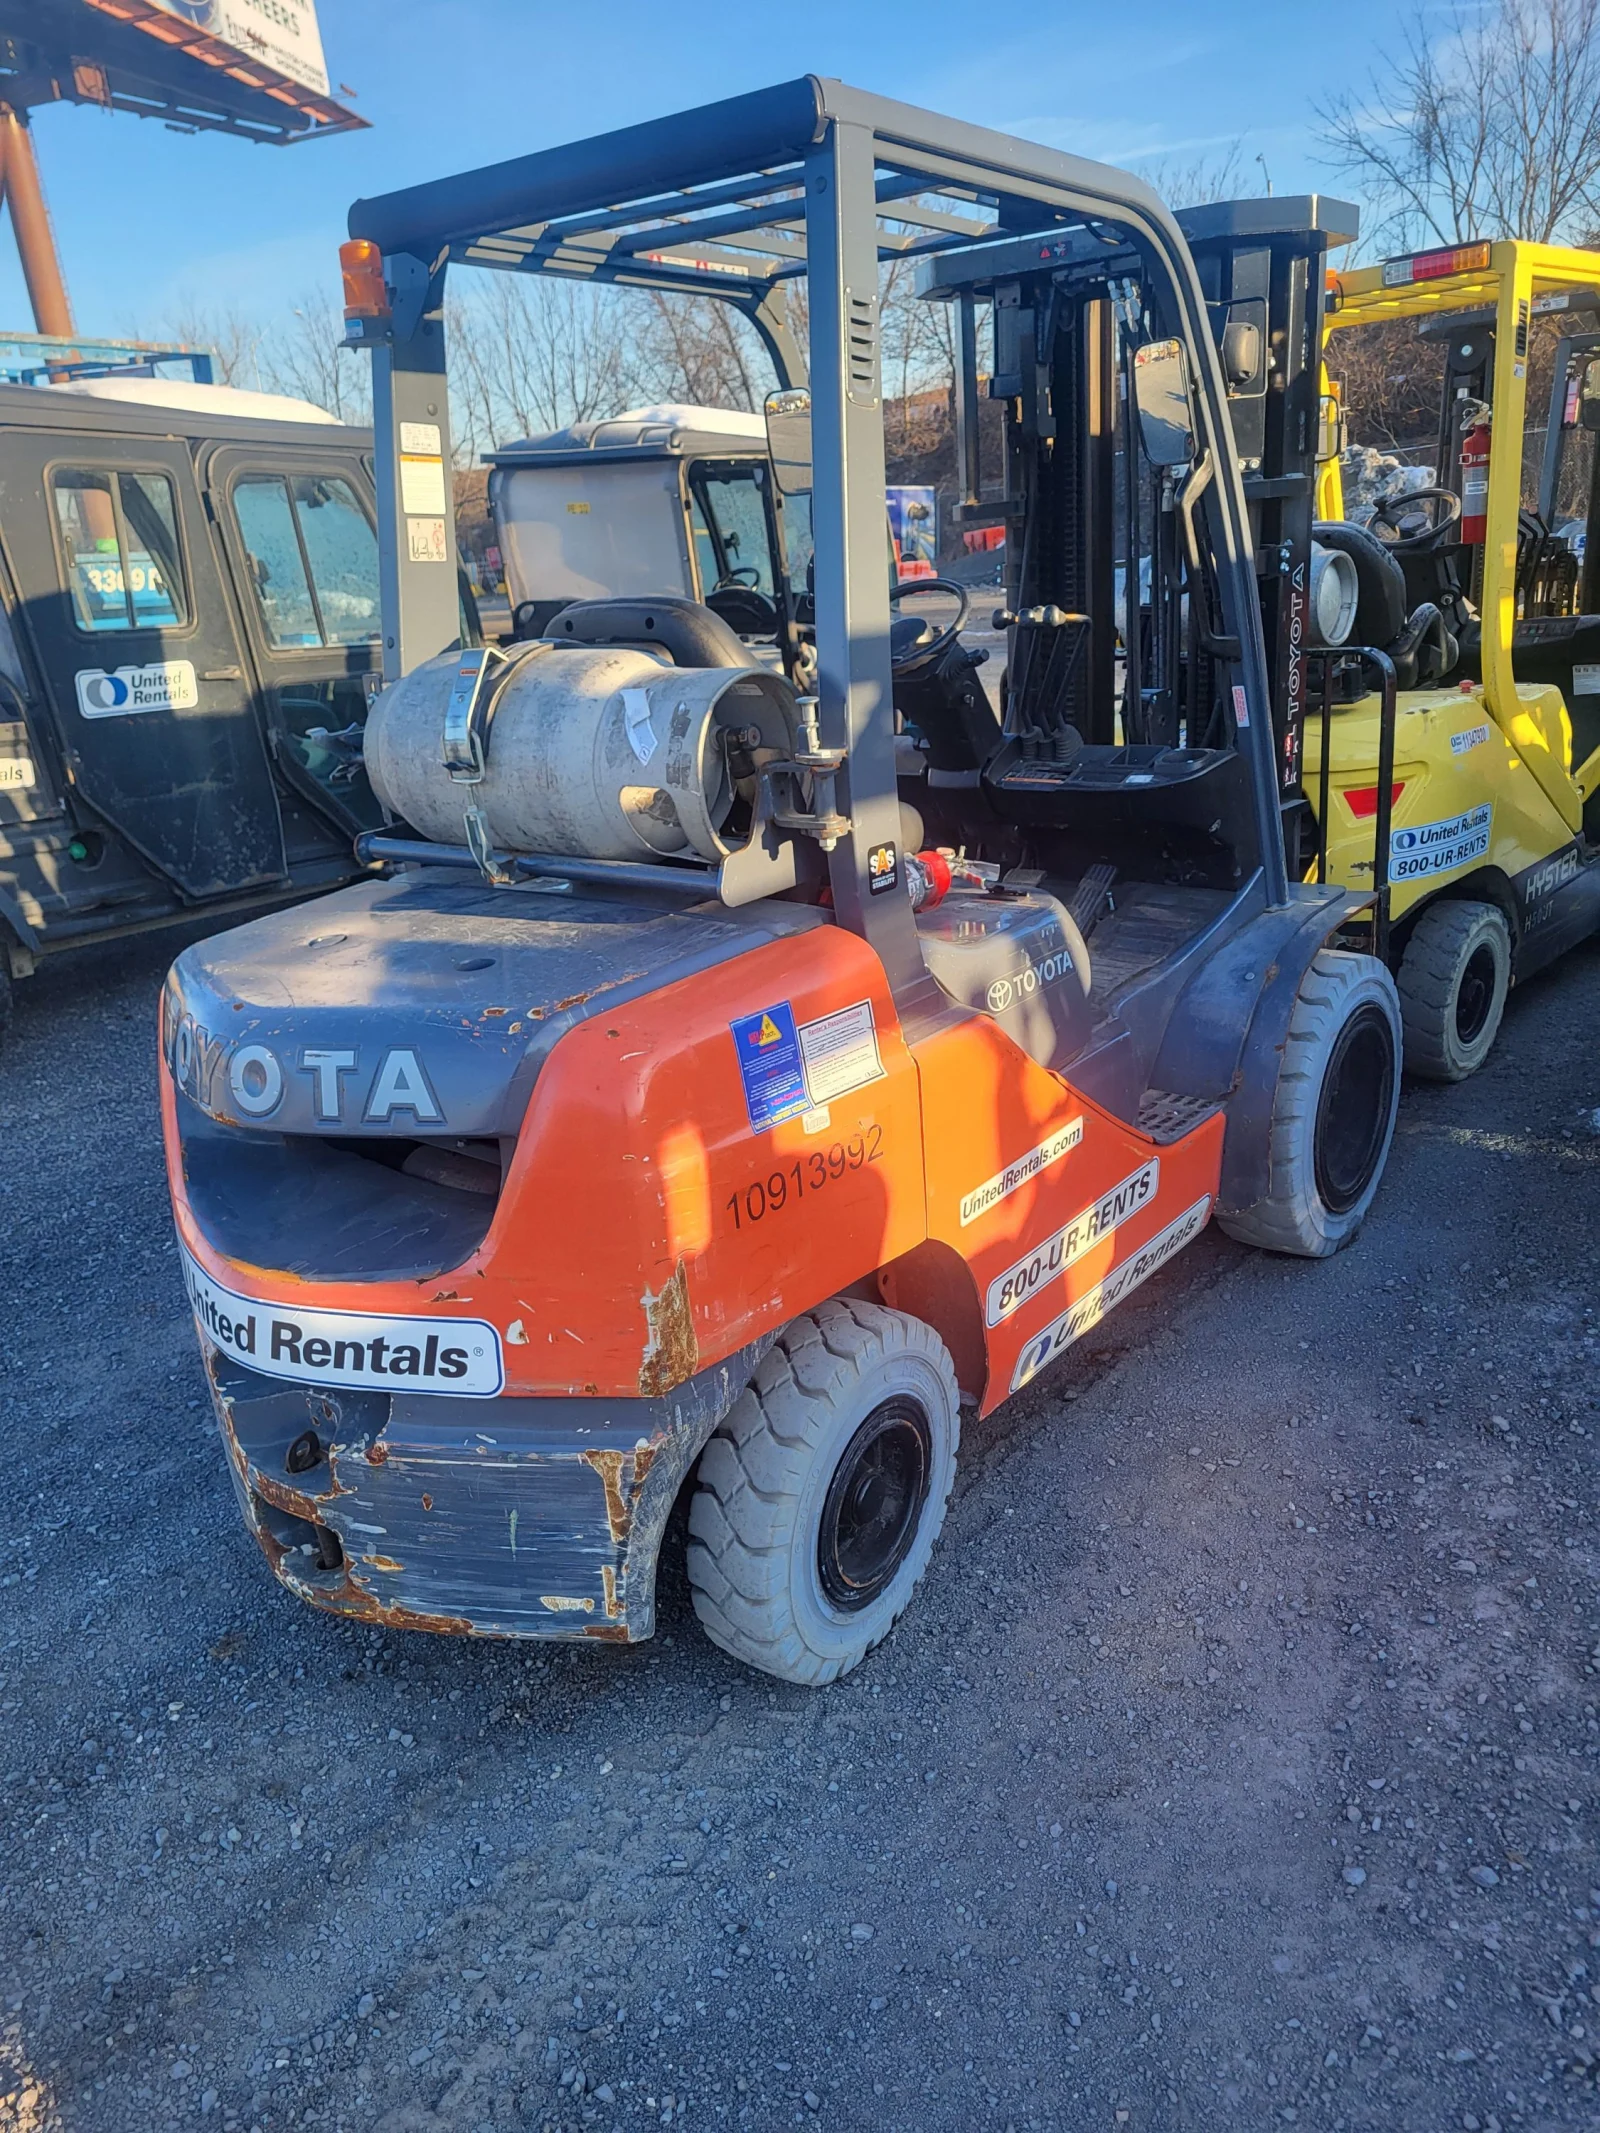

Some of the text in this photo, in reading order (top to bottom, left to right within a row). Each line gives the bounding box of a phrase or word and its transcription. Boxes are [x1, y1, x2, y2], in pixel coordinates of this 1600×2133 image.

[246, 0, 300, 36] HEERS
[1288, 562, 1304, 720] TOYOTA
[131, 671, 182, 688] United
[134, 687, 189, 704] Rentals
[1420, 820, 1459, 844] United
[870, 848, 895, 875] SAS
[1397, 834, 1487, 876] 800-UR-RENTS
[1525, 848, 1577, 904] HYSTER
[1013, 951, 1073, 996] TOYOTA
[726, 1123, 884, 1230] 10913992
[963, 1127, 1080, 1219] UnitedRentals.com
[999, 1170, 1151, 1310] 800-UR-RENTS
[1054, 1215, 1199, 1349] United Rentals
